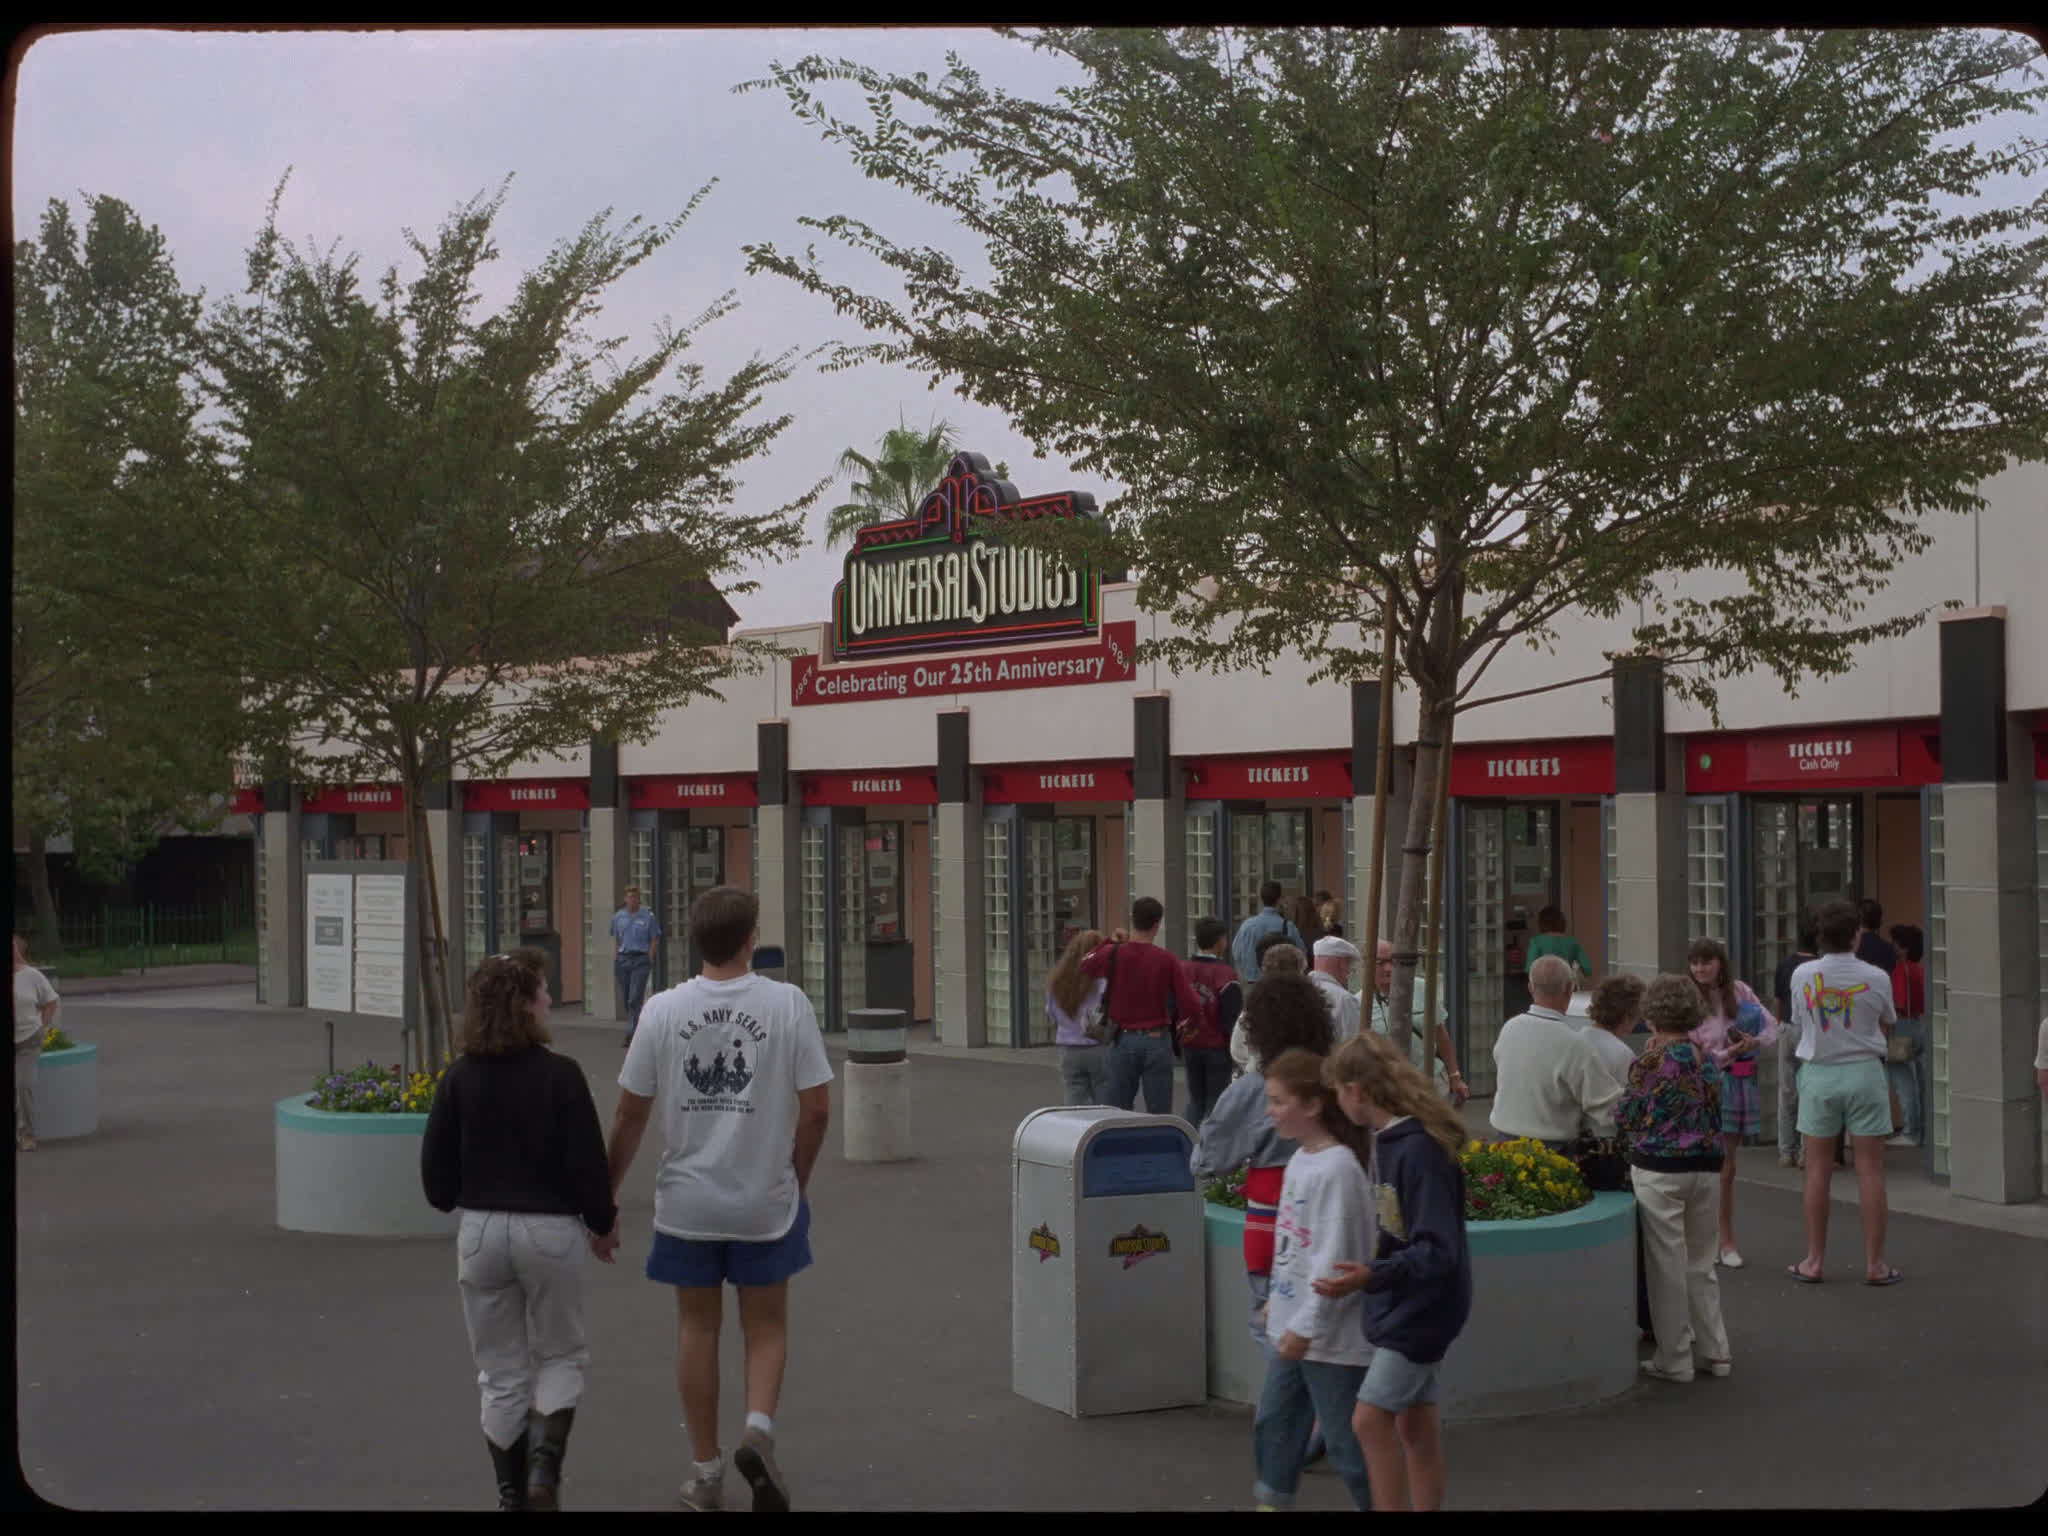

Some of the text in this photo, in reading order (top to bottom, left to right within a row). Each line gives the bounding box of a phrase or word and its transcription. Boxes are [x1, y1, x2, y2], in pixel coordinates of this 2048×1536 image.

[851, 550, 971, 635] UNIVERSAL
[795, 664, 813, 702] 1964
[815, 655, 1105, 695] Celebrating Our 25th Anniversary
[1789, 740, 1852, 758] TICKETS
[1486, 757, 1561, 777] TICKETS
[1799, 757, 1840, 772] Cash Only
[1039, 773, 1095, 789] TICKETS
[1247, 766, 1309, 783] TICKETS
[510, 787, 557, 801] TICKETS
[677, 783, 725, 797] TICKETS
[851, 779, 902, 792] TICKETS
[680, 1008, 767, 1042] U.S. NAVY SEALS
